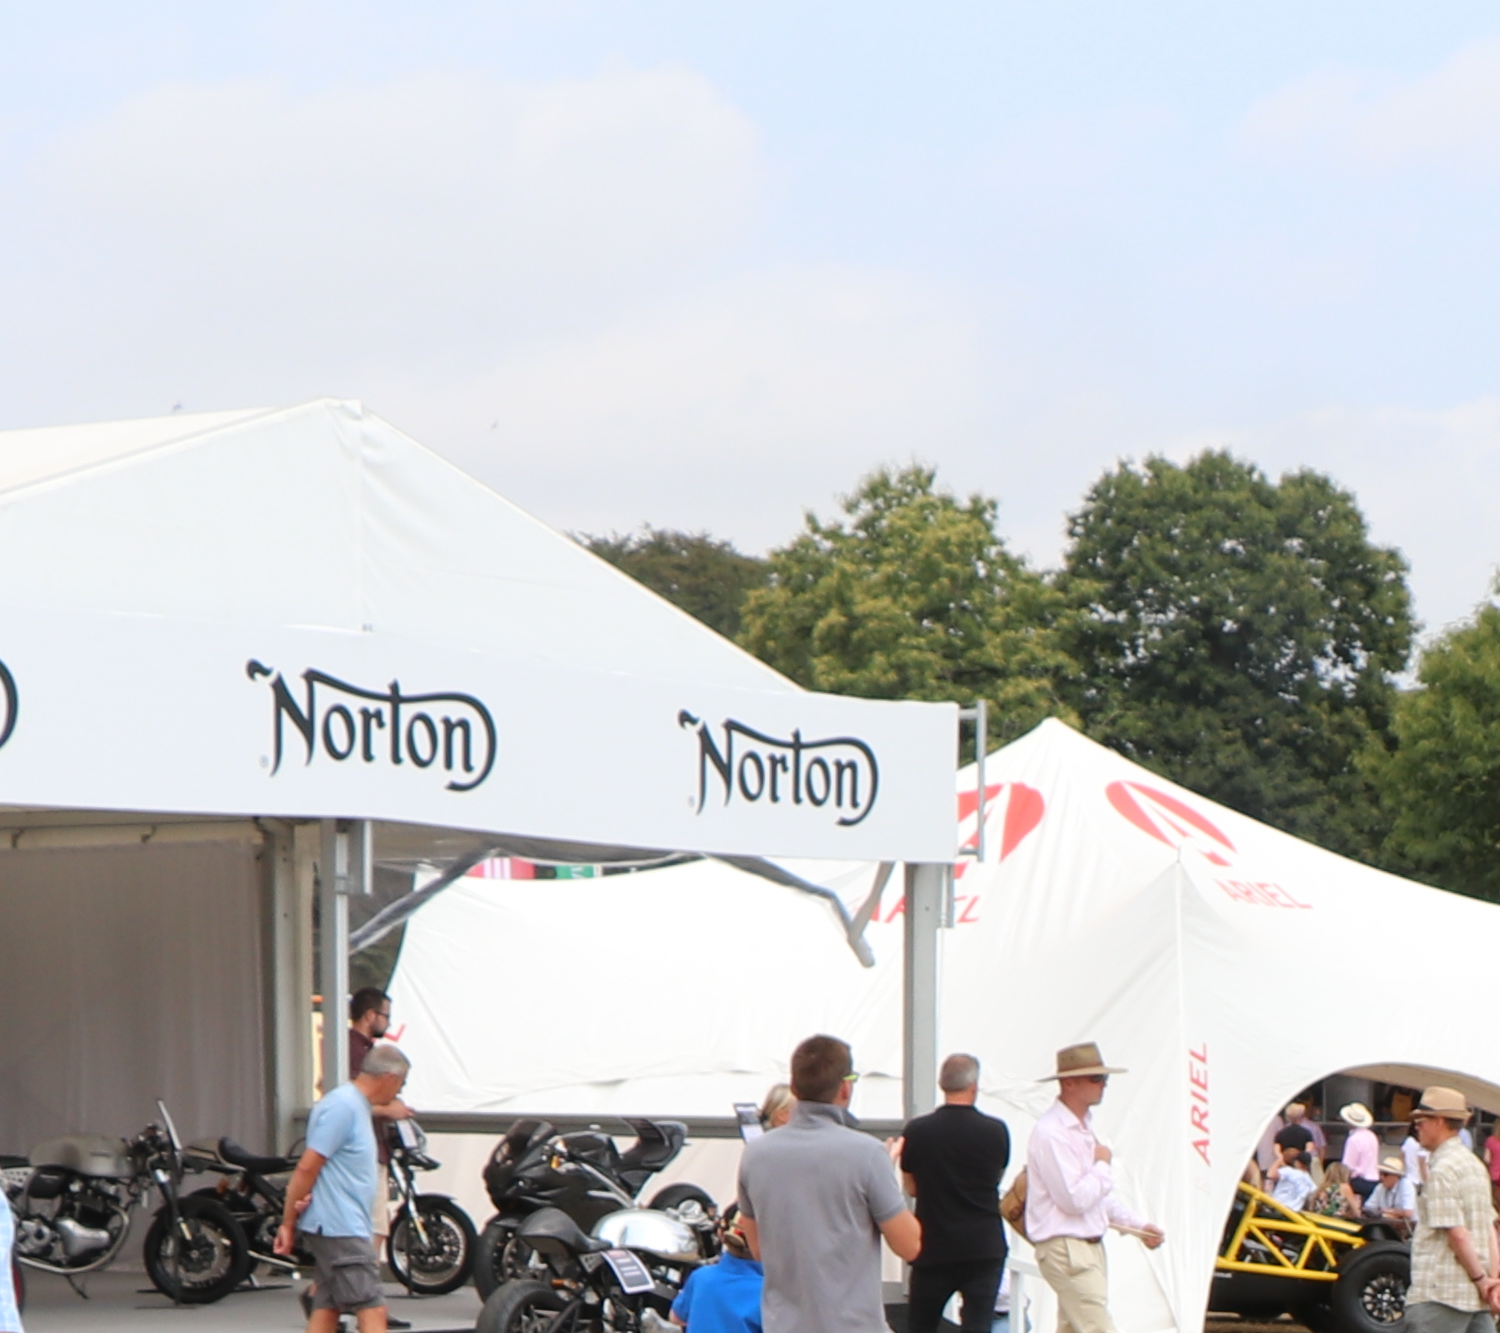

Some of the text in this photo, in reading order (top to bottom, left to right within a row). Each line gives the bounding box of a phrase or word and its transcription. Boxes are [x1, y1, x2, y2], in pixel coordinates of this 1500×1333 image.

[245, 658, 497, 792] Norton
[678, 709, 878, 826] Norton
[1212, 878, 1313, 909] ARIEL
[1189, 1041, 1211, 1167] ARIEL
